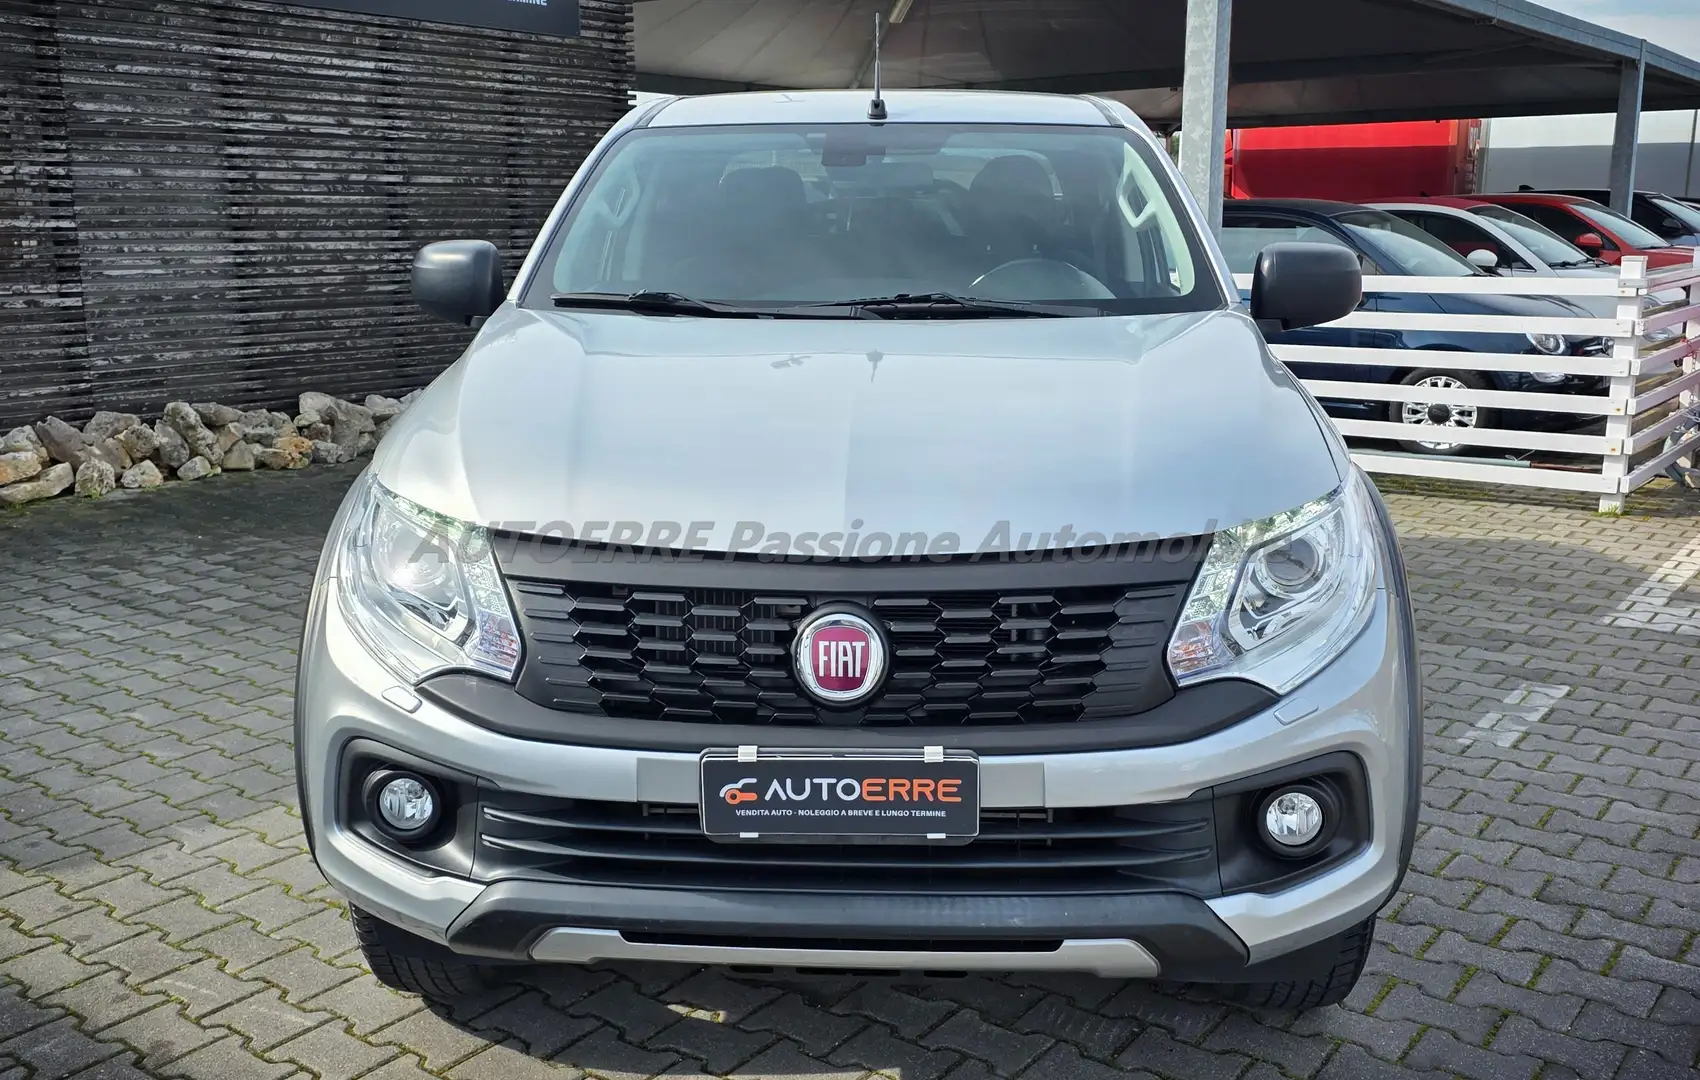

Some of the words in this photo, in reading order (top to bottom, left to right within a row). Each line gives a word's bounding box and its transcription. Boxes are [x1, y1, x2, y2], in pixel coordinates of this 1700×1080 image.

[818, 640, 866, 678] FIAT
[764, 777, 963, 802] AUTOERRE
[874, 809, 881, 817] E
[881, 809, 910, 817] LUNGO
[910, 810, 947, 818] TERMINE
